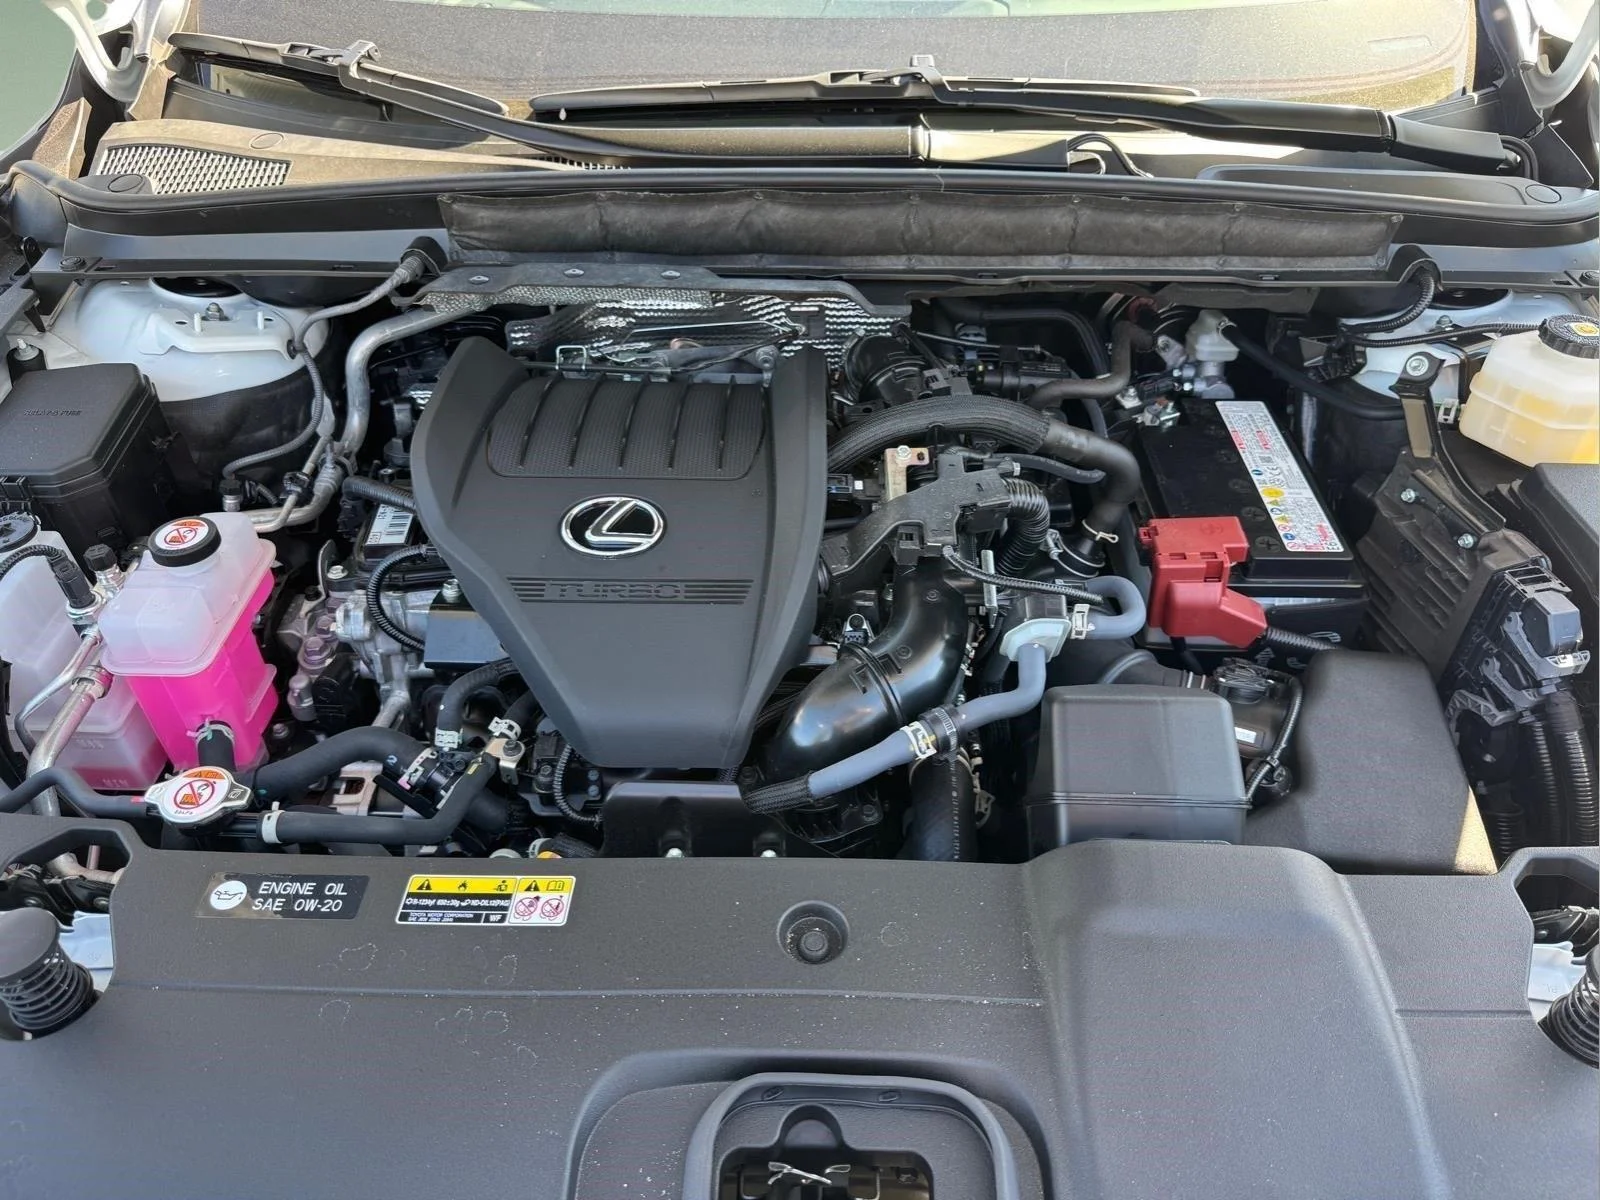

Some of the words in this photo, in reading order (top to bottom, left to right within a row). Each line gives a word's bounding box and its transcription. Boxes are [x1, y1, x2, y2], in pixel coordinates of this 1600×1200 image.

[551, 583, 681, 599] TURBO
[258, 881, 317, 896] ENGINE
[324, 882, 348, 896] OIL
[252, 898, 286, 911] SAE
[294, 899, 343, 912] 0W-20
